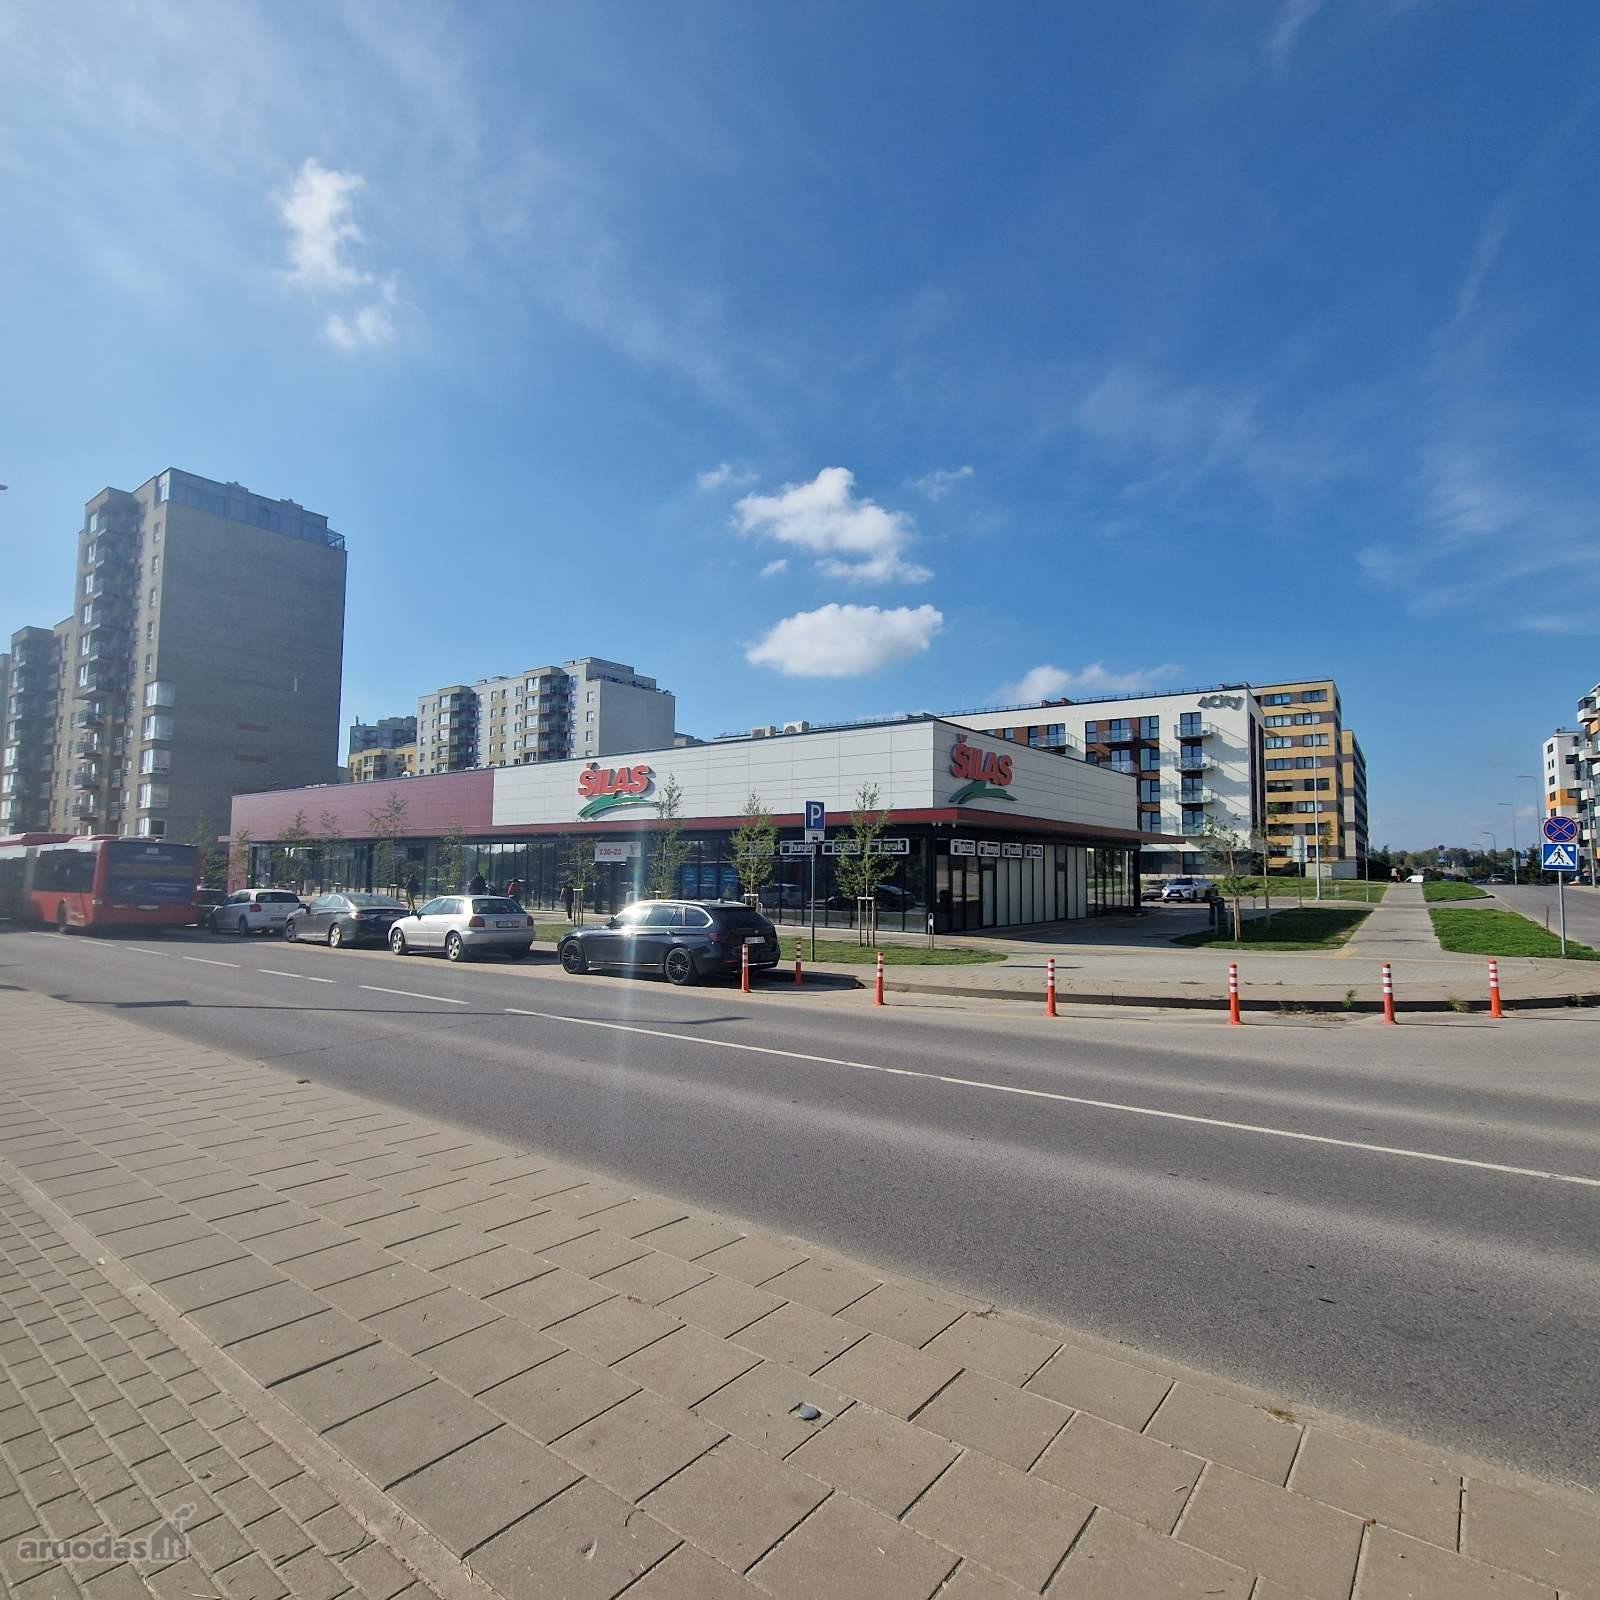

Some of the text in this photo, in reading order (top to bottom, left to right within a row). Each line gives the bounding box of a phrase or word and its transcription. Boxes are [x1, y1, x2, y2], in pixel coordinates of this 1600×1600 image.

[951, 734, 1013, 786] ŠILAS
[577, 762, 654, 797] ŠILAS
[810, 804, 821, 827] P
